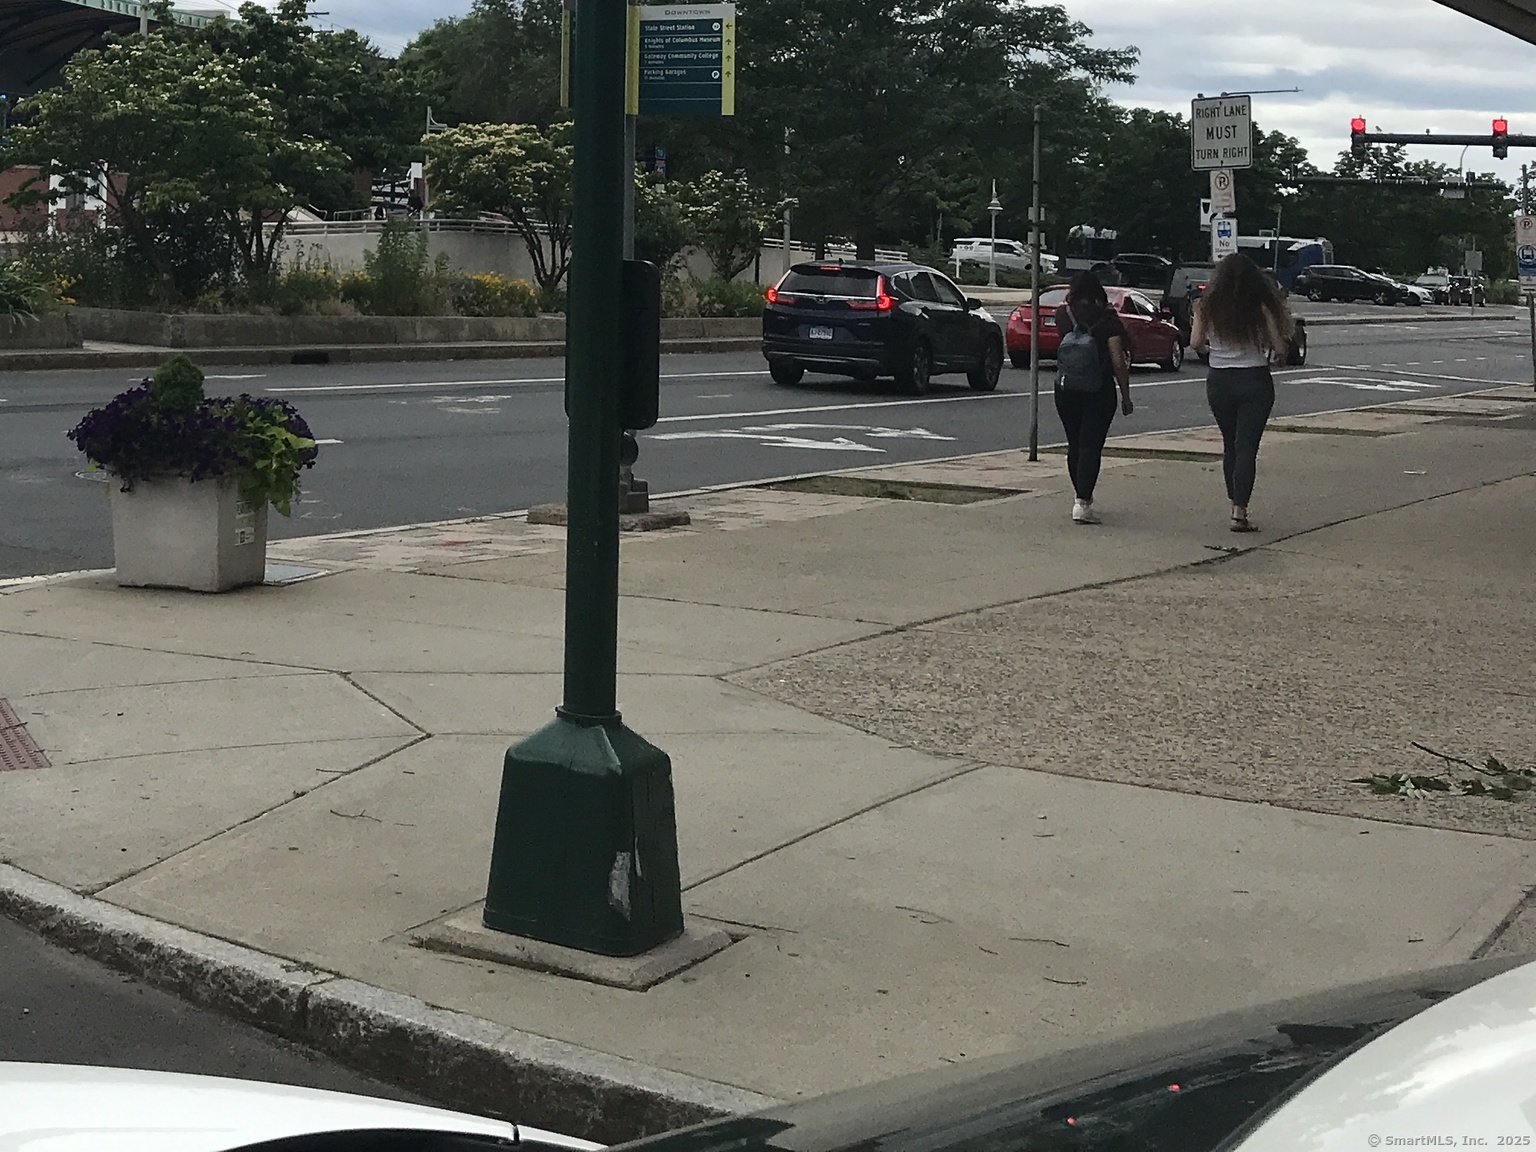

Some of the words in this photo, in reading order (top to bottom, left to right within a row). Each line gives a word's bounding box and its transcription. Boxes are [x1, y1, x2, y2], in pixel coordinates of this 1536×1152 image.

[667, 52, 697, 60] Community
[698, 52, 719, 60] College
[1195, 106, 1221, 119] RIGHT
[1223, 104, 1247, 117] LANE
[1206, 125, 1238, 140] MUST
[1195, 148, 1219, 160] TURN
[1222, 146, 1248, 159] RIGHT
